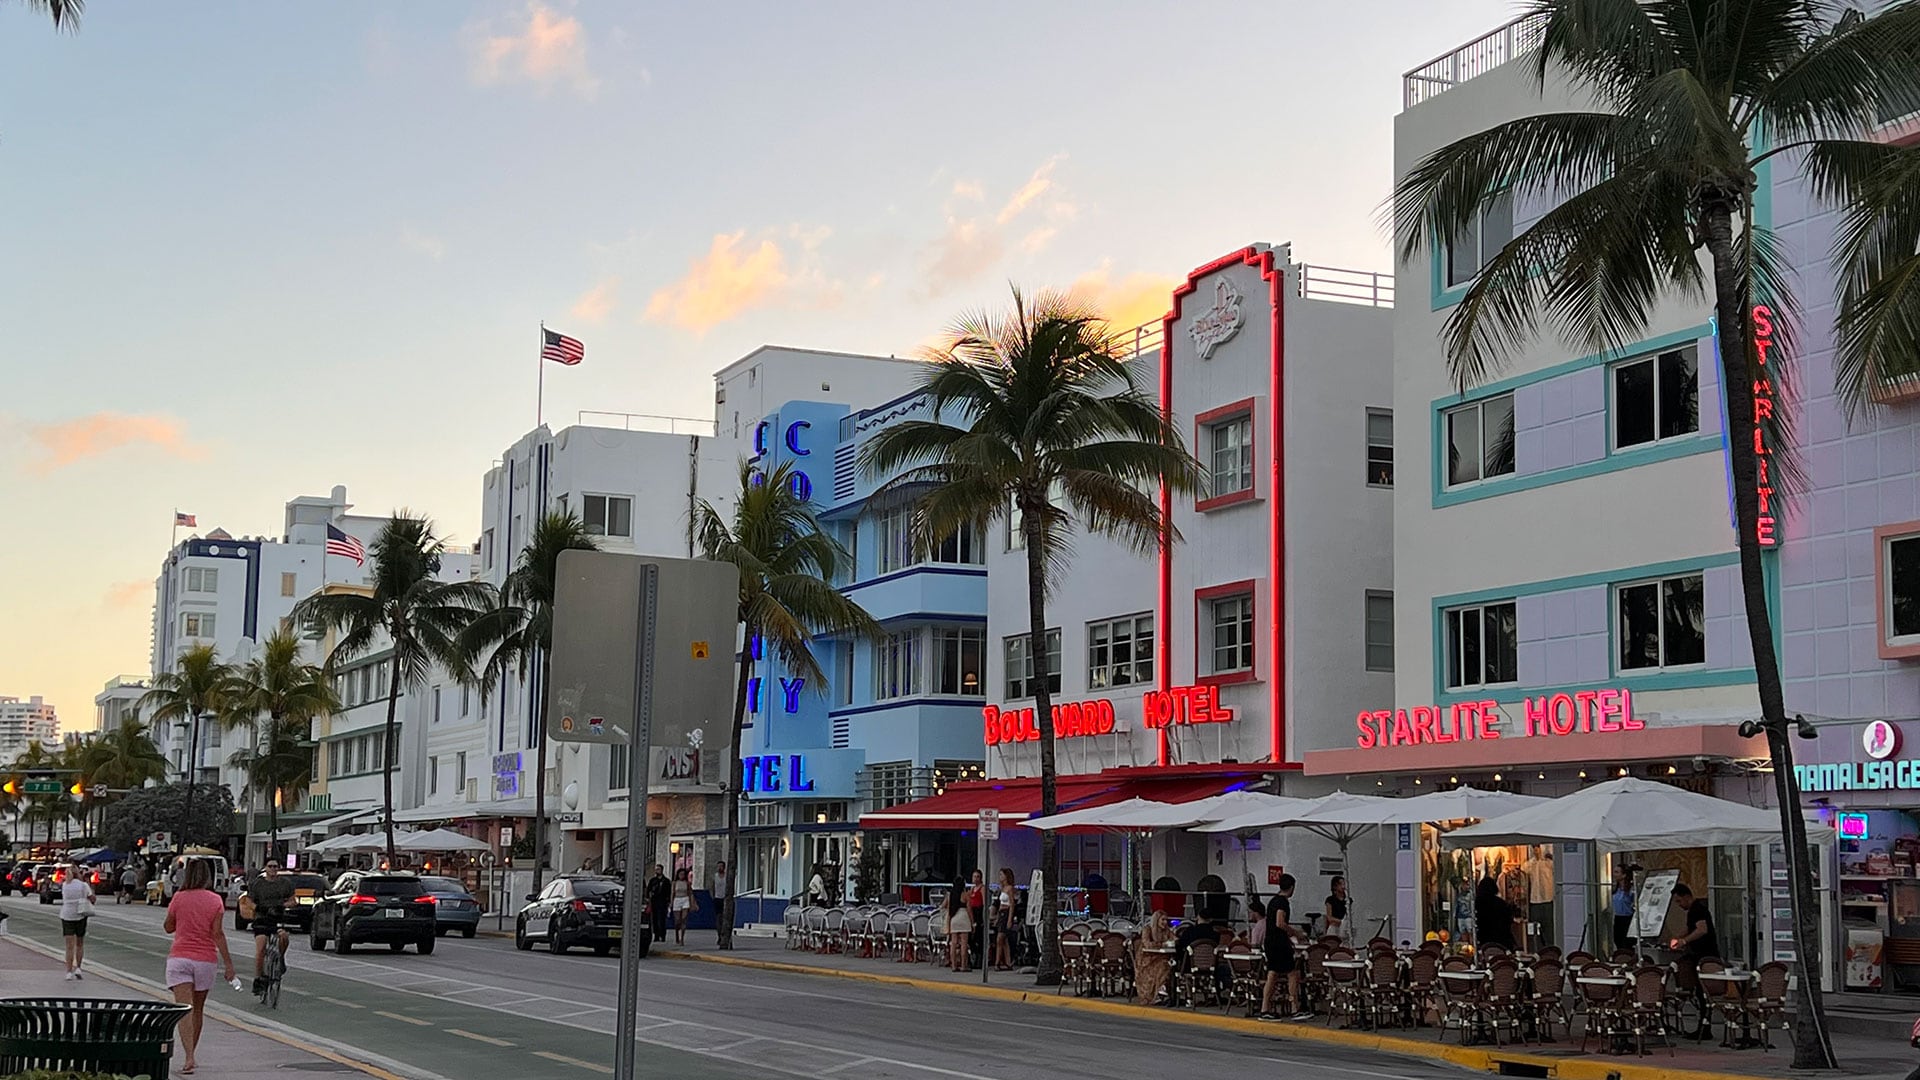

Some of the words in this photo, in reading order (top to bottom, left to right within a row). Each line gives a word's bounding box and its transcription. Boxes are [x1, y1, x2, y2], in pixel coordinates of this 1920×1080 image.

[983, 699, 1115, 746] BOULVARD
[1143, 685, 1234, 729] HOTEL
[1357, 700, 1500, 749] STARLITE
[1524, 688, 1645, 737] HOTEL
[667, 751, 690, 777] CVS
[743, 754, 815, 792] TEL
